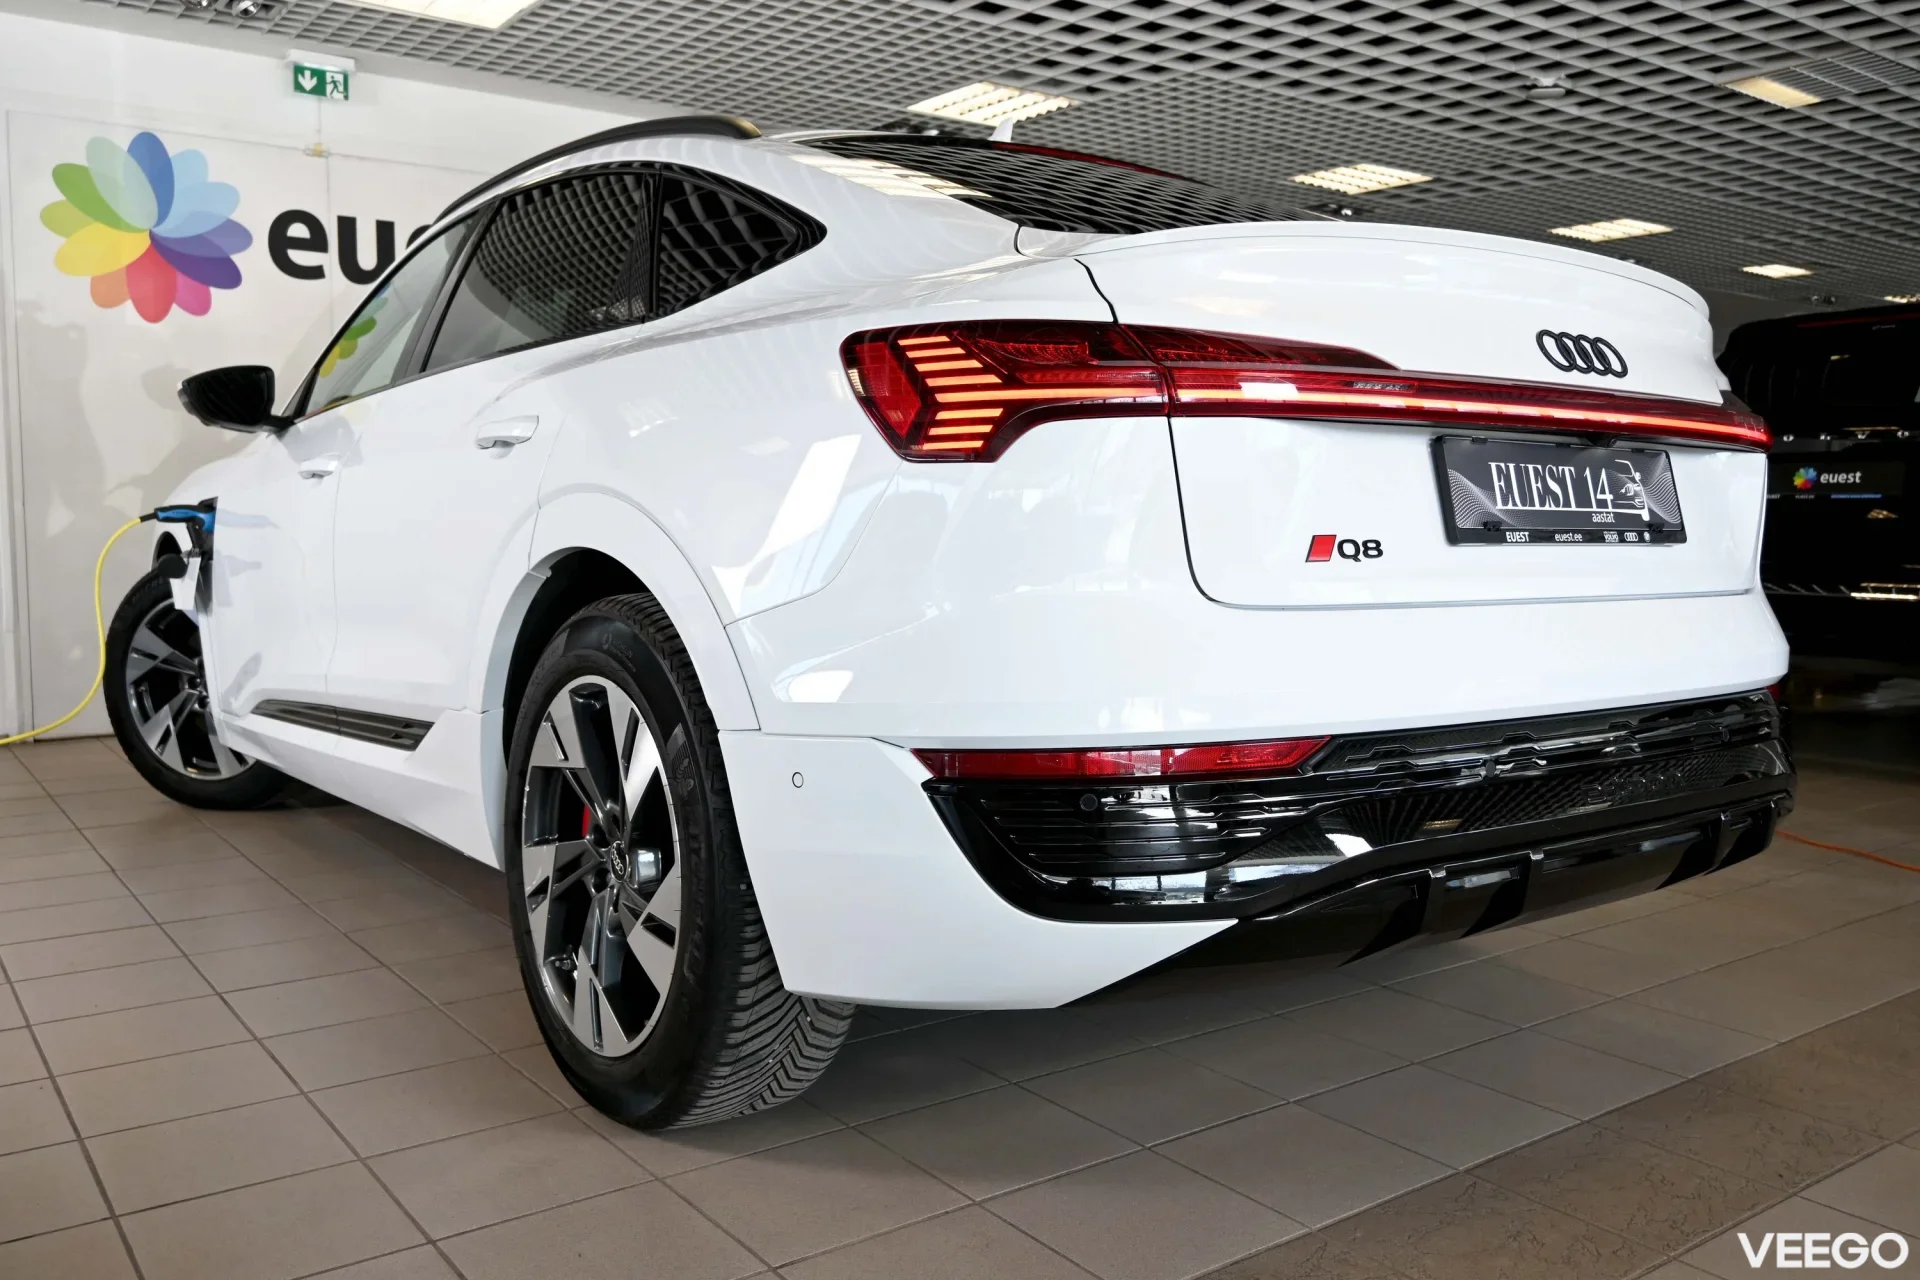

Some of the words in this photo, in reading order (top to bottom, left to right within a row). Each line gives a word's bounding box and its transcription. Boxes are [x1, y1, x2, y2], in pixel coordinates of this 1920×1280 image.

[1783, 430, 1909, 442] OLVO
[1820, 471, 1862, 484] euest
[1488, 462, 1576, 509] EUEST
[1583, 466, 1614, 510] 14
[1592, 512, 1615, 523] aastat
[1505, 531, 1530, 543] EUEST
[1554, 532, 1583, 542] euest.ee
[1337, 538, 1384, 562] Q8
